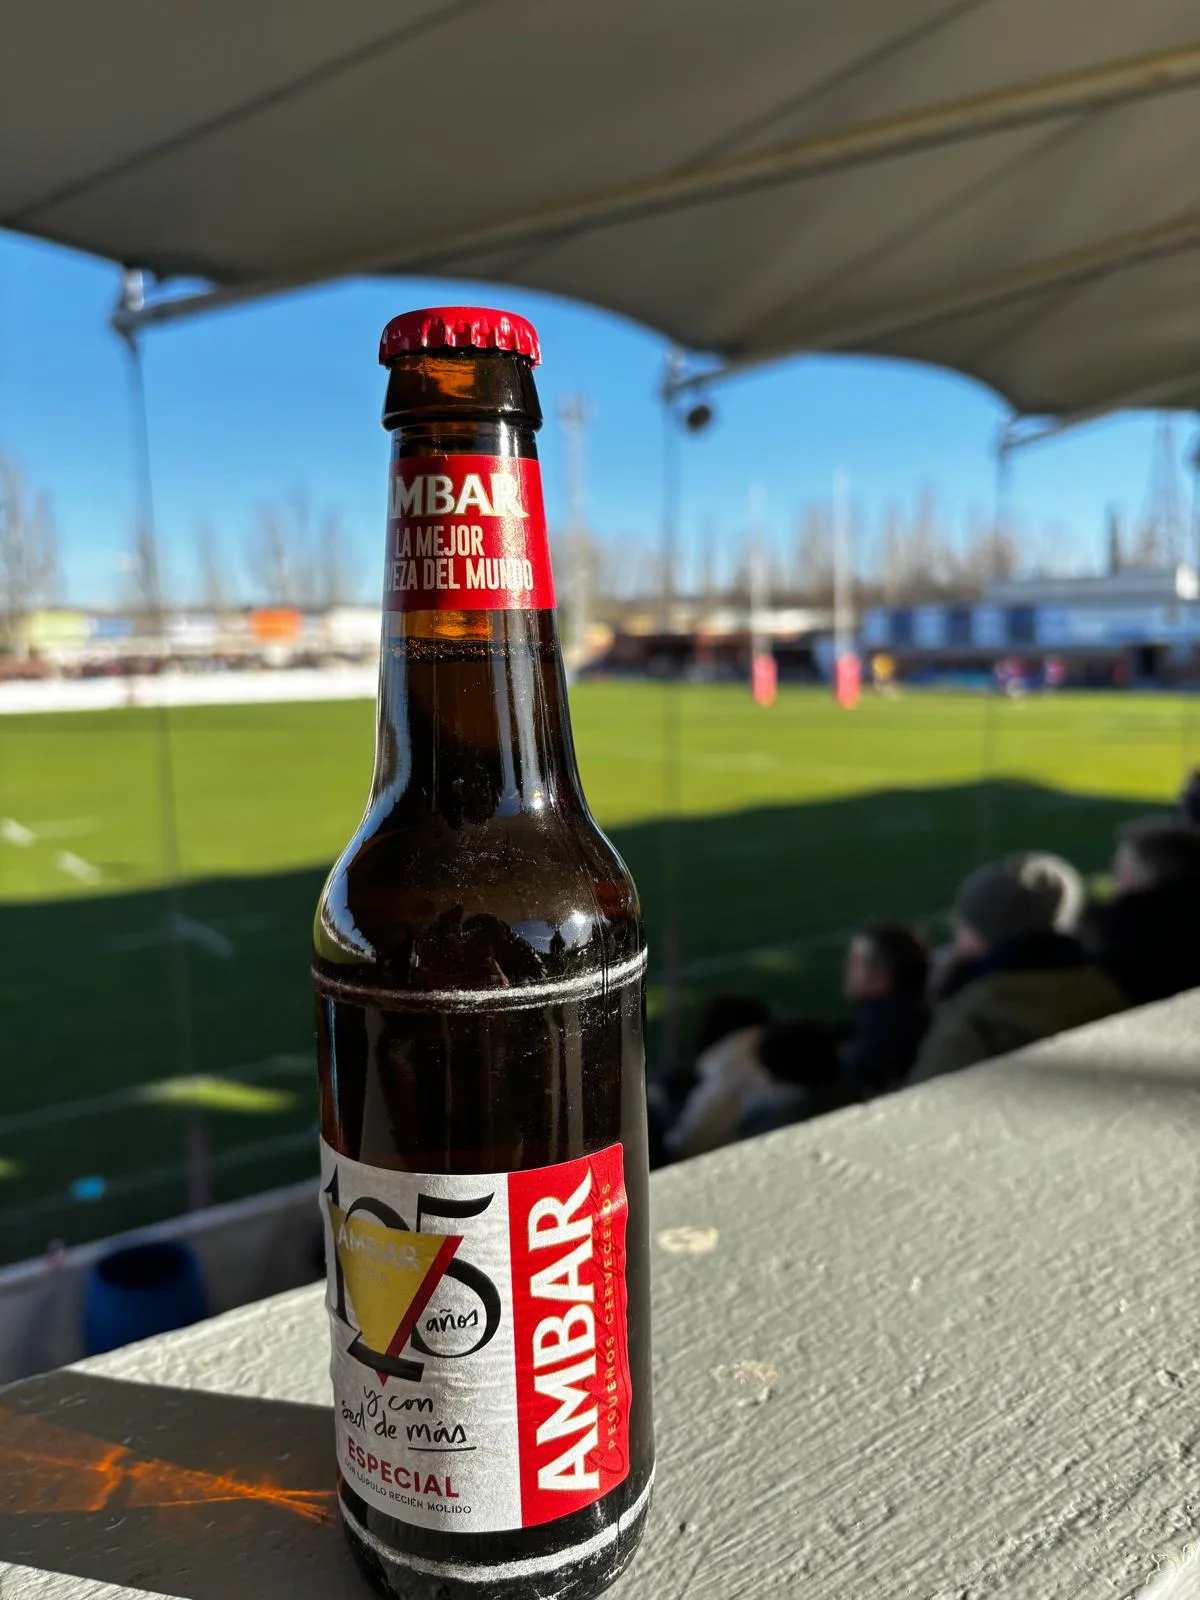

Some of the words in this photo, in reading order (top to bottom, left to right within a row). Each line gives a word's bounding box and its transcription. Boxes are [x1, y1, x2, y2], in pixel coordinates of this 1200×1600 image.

[395, 526, 413, 559] LA
[415, 524, 486, 558] MEJOR
[423, 558, 461, 590] DEL
[466, 558, 534, 591] MUNDO
[426, 1309, 479, 1333] años
[527, 1166, 601, 1492] AMBAR
[364, 1385, 383, 1418] y
[388, 1395, 434, 1413] con
[374, 1410, 398, 1440] de
[406, 1421, 468, 1444] más
[347, 1435, 460, 1498] ESPECIAL
[389, 1490, 424, 1509] RECIÉN
[427, 1503, 472, 1514] MOLIDO
